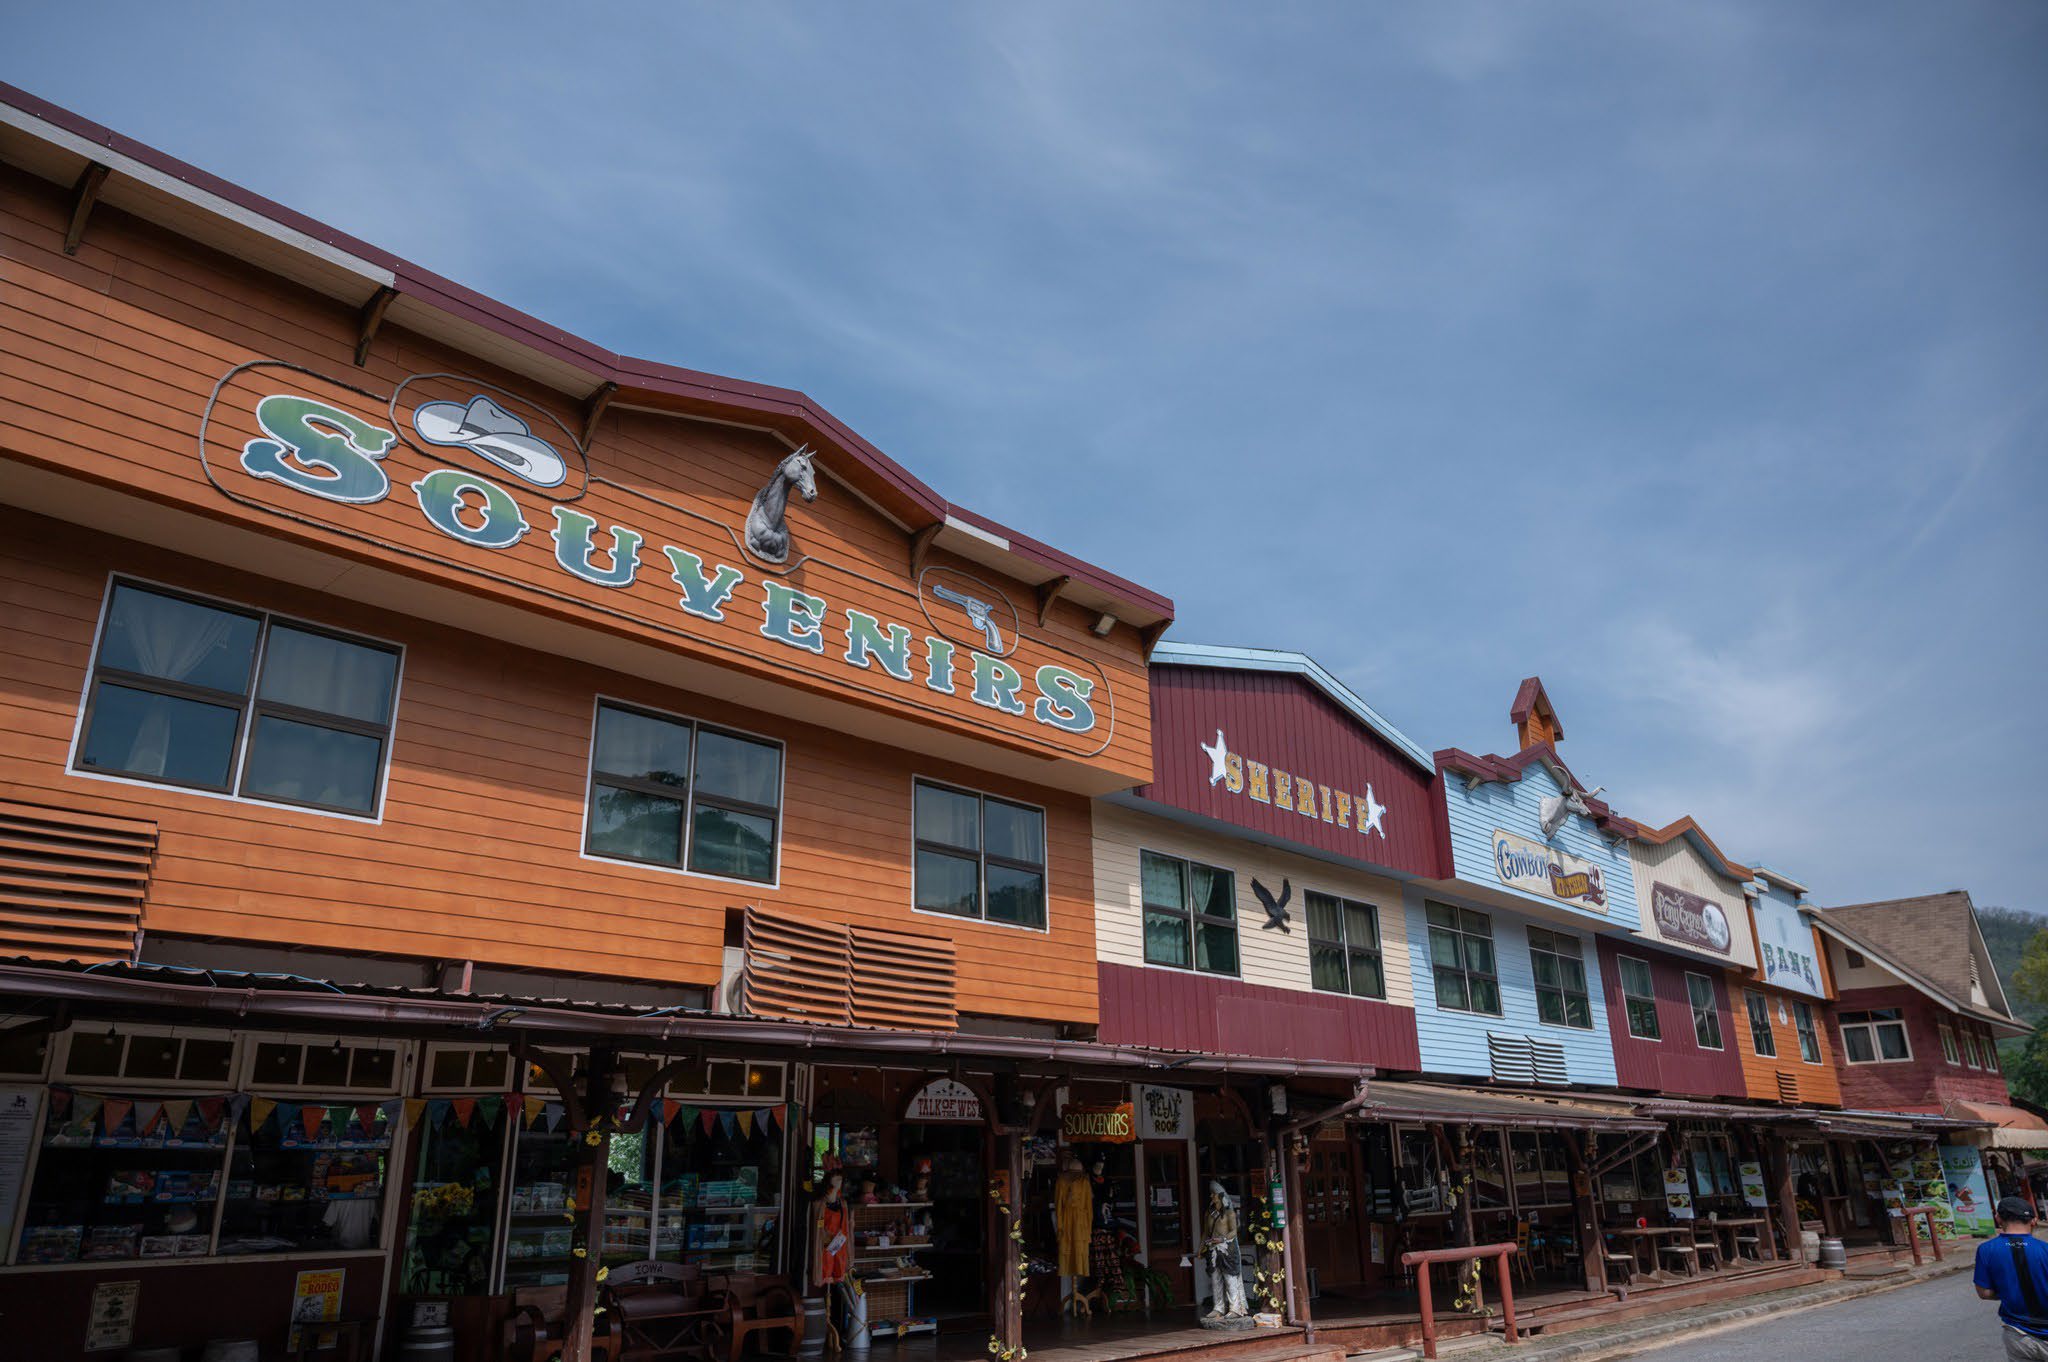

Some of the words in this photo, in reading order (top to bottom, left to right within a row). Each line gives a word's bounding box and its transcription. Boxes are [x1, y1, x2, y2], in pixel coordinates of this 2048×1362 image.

[240, 394, 1096, 734] SOUVENIRS
[1225, 752, 1370, 834] SHERIFF
[1762, 942, 1818, 993] BANK
[918, 1099, 941, 1116] TALK
[942, 1099, 957, 1109] OF
[1064, 1112, 1129, 1136] SOUVENIRS
[1155, 1120, 1178, 1133] ROOM
[635, 1264, 663, 1274] IOWA
